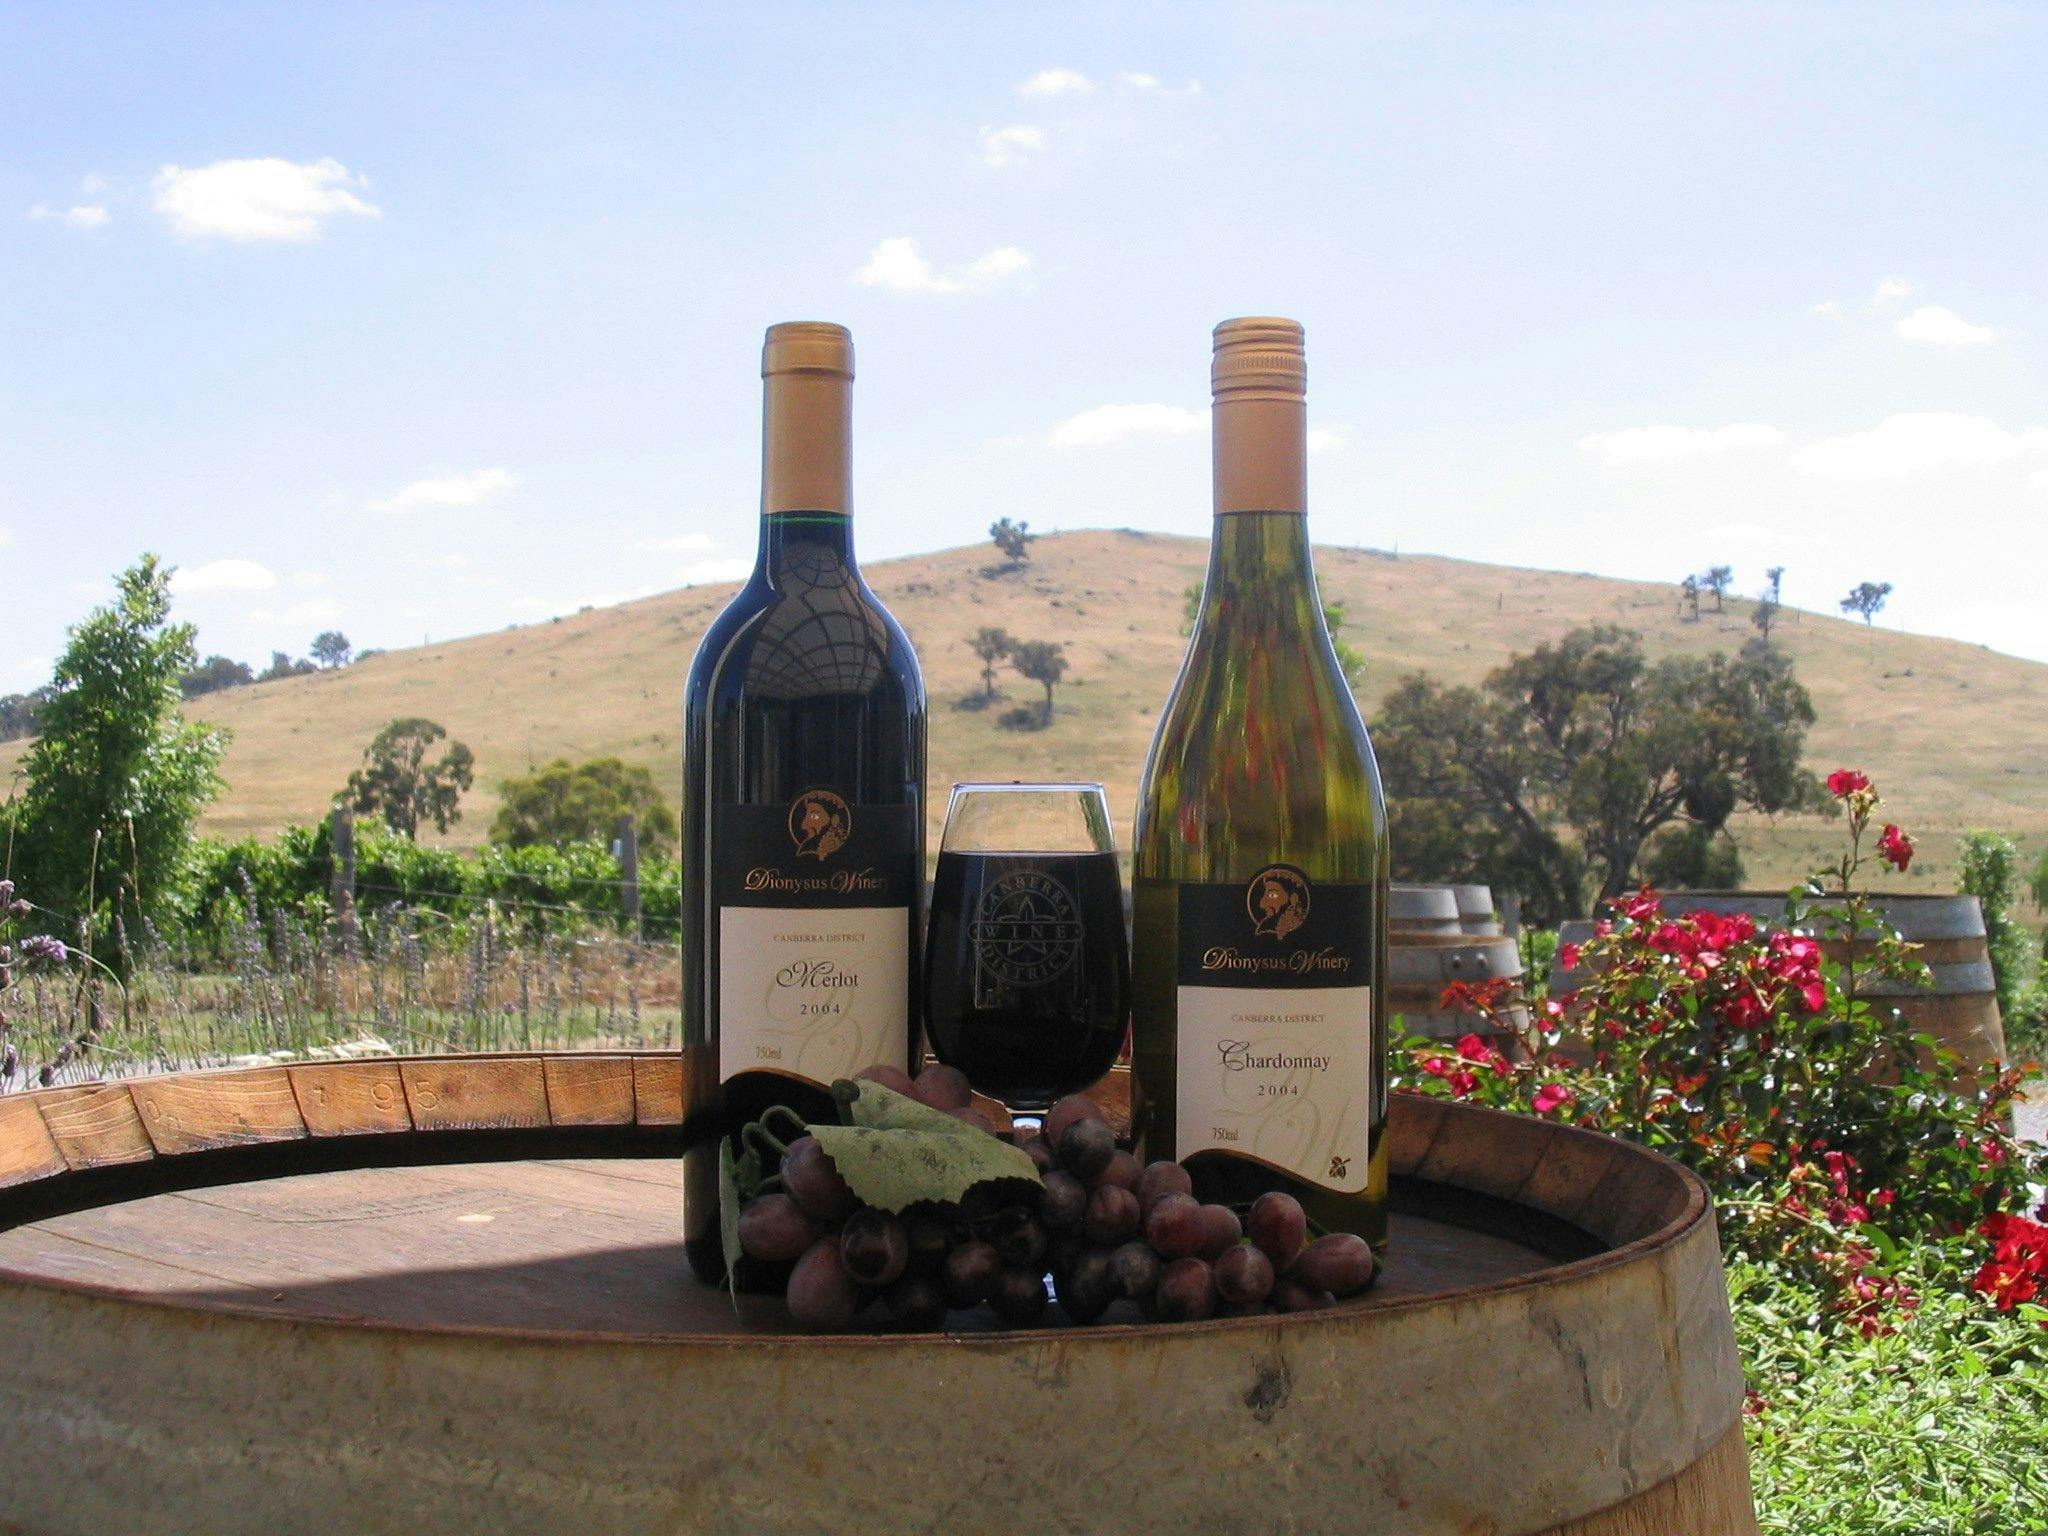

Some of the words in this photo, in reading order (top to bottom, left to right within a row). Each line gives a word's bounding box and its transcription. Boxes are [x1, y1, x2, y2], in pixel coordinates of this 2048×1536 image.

[744, 867, 828, 894] Dionysus
[981, 876, 1070, 916] CANBERRA
[773, 933, 824, 942] CANBERRA
[827, 933, 865, 942] DISTRICT
[982, 924, 1067, 939] WINE
[981, 943, 1070, 980] DISTRICT
[1202, 946, 1286, 972] Dionysus
[1289, 947, 1351, 974] Winery
[776, 960, 859, 988] Merlot
[801, 1003, 841, 1015] 2004
[1231, 1014, 1282, 1023] CANBERRA
[1285, 1014, 1325, 1023] DISTRICT
[1217, 1039, 1331, 1073] Chardonnay
[1257, 1085, 1299, 1097] 2004
[1212, 1127, 1240, 1142] 750ml
